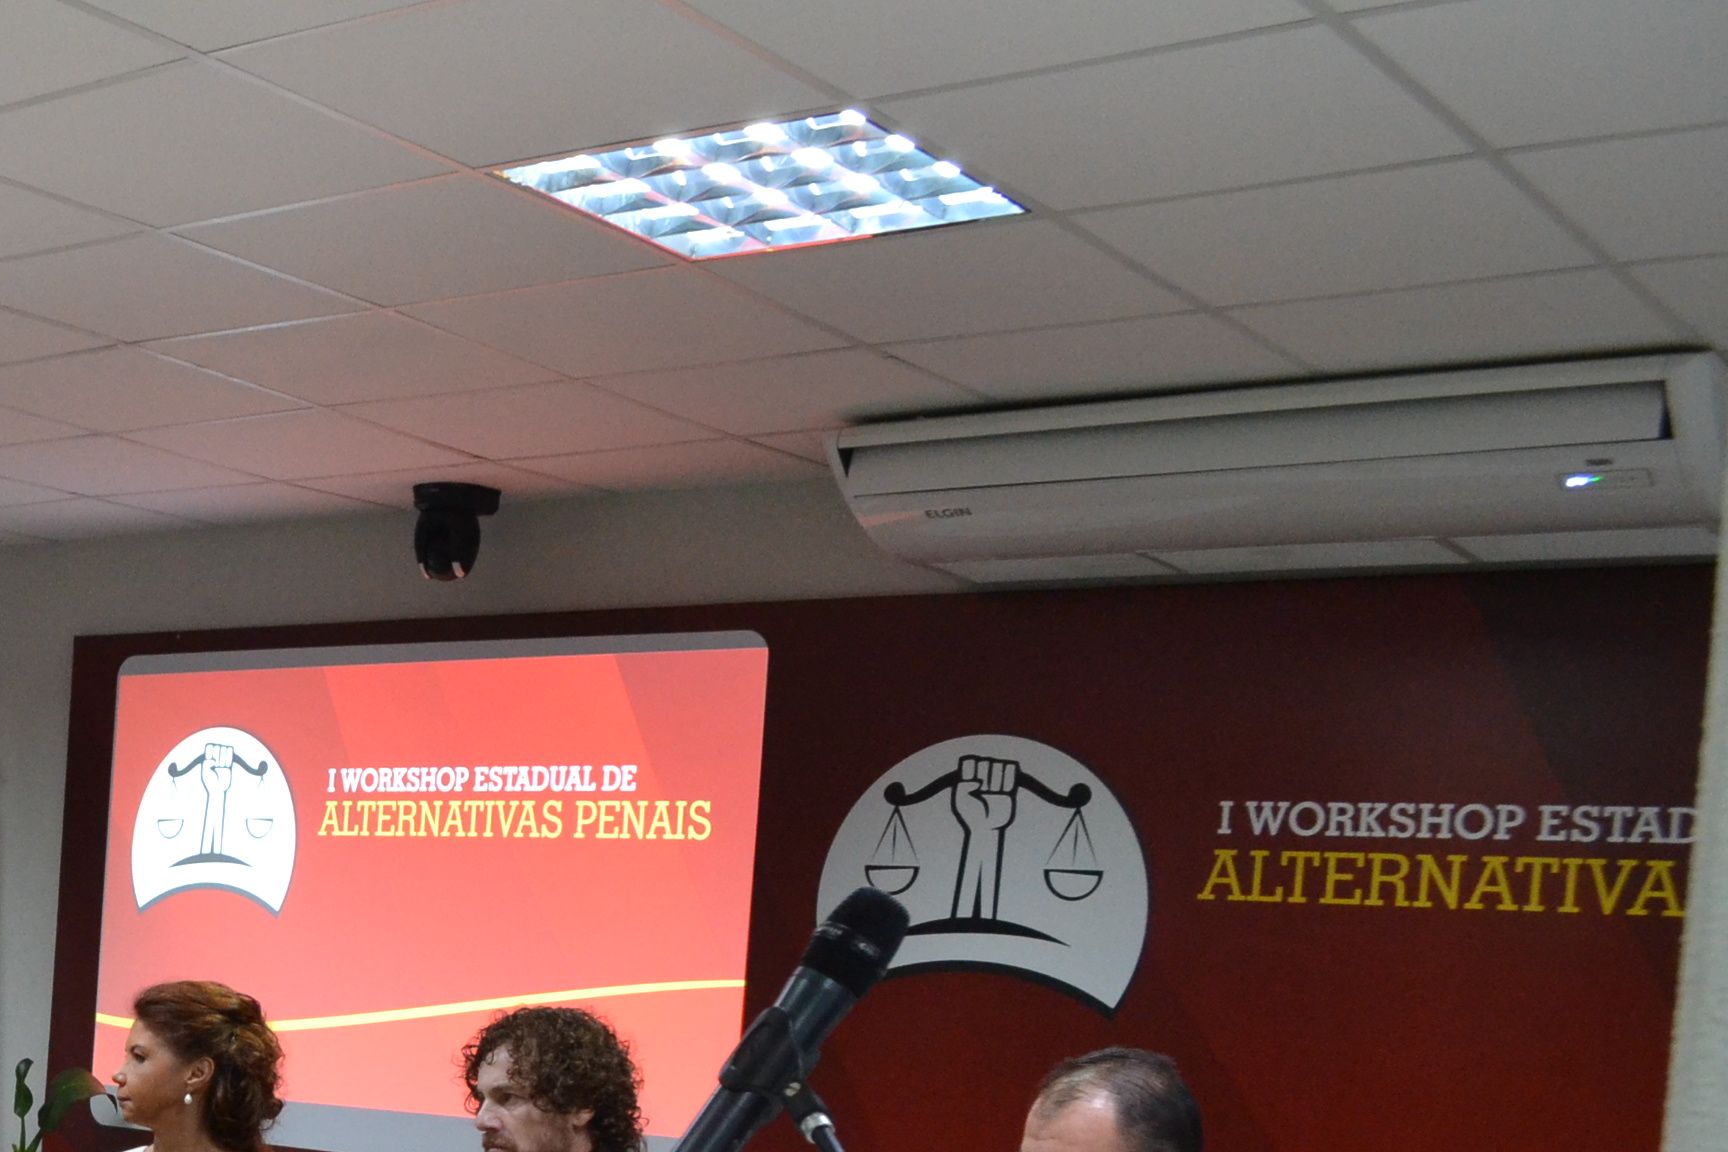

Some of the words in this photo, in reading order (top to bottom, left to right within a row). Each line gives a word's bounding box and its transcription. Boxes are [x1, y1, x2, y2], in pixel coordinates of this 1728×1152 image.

[924, 507, 973, 519] ELGIN
[327, 768, 337, 793] I
[340, 766, 470, 793] WORKSHOP
[473, 765, 597, 792] ESTADUAL
[601, 765, 638, 792] DE
[317, 800, 563, 839] ALTERNATIVAS
[573, 800, 713, 841] PENAIS
[1217, 801, 1234, 834] I
[1245, 801, 1527, 840] WORKSHOP
[1196, 849, 1687, 918] ALTERNATIVA
